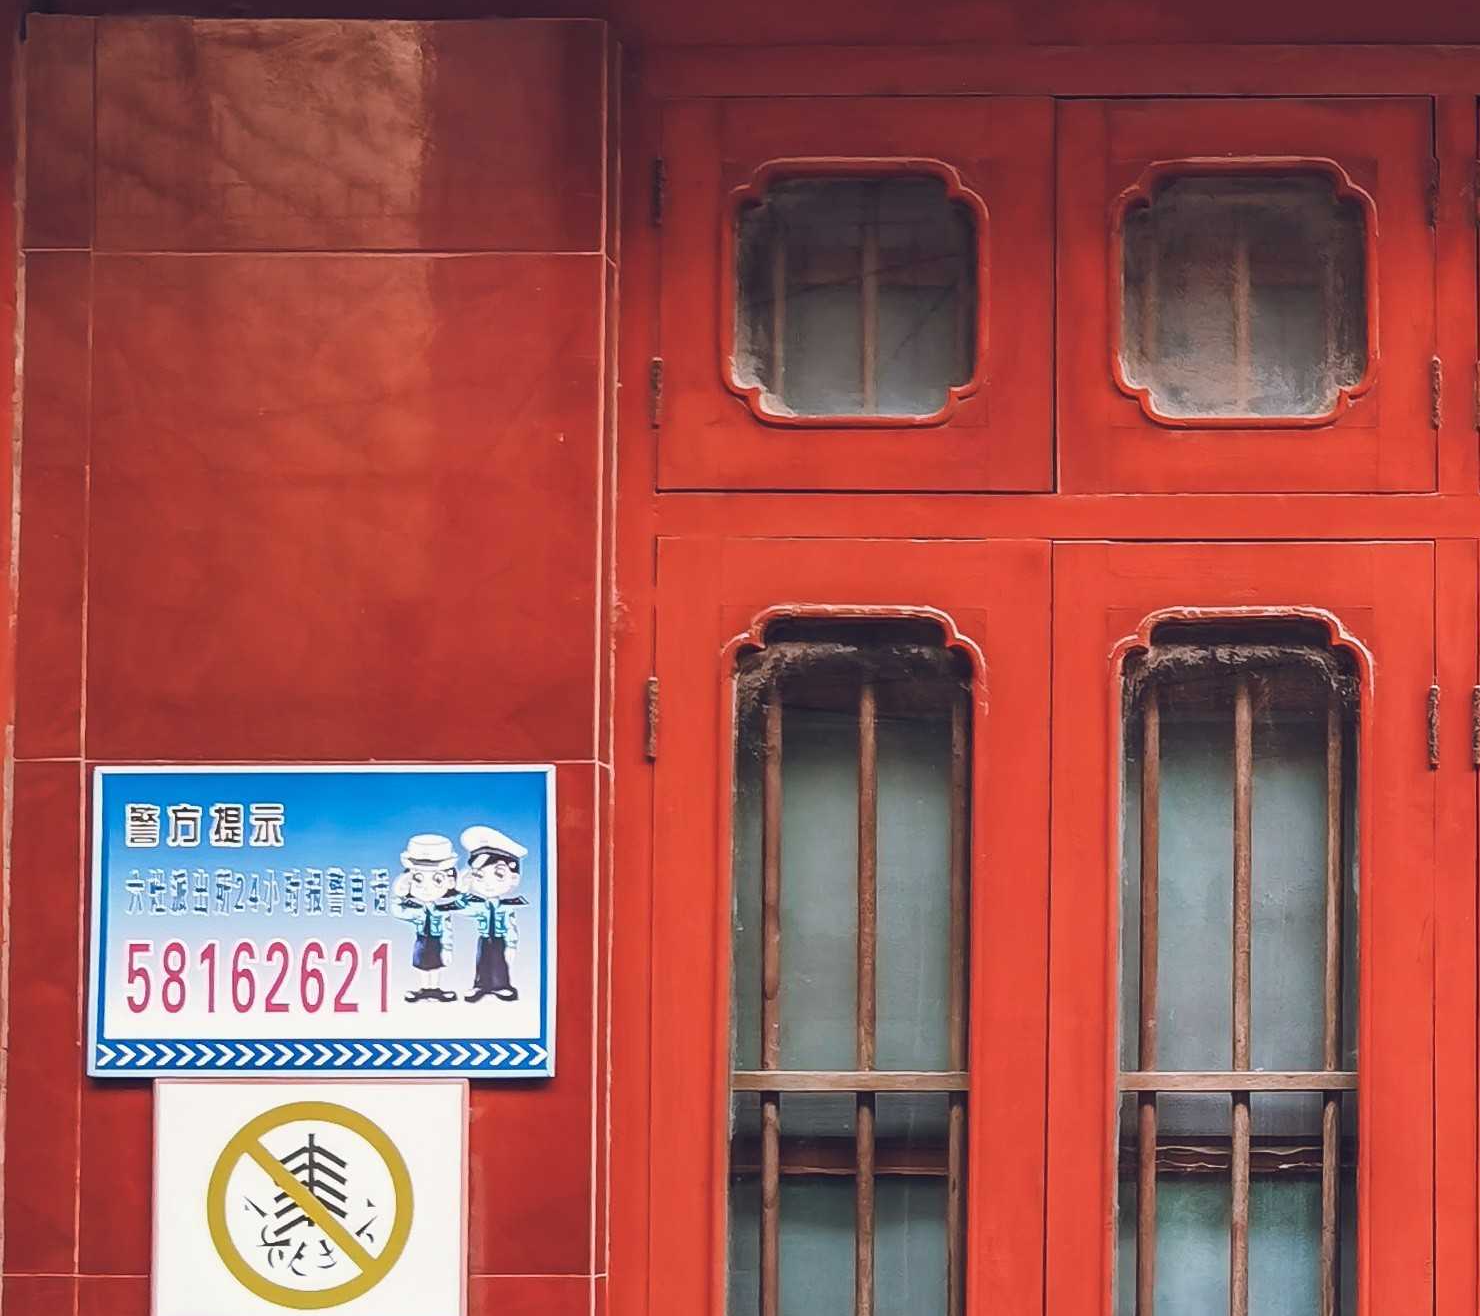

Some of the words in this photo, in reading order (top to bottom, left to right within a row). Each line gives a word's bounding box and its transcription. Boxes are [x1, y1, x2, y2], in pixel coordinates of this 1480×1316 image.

[125, 803, 284, 847] 警方提示
[126, 941, 390, 1014] 58162621
